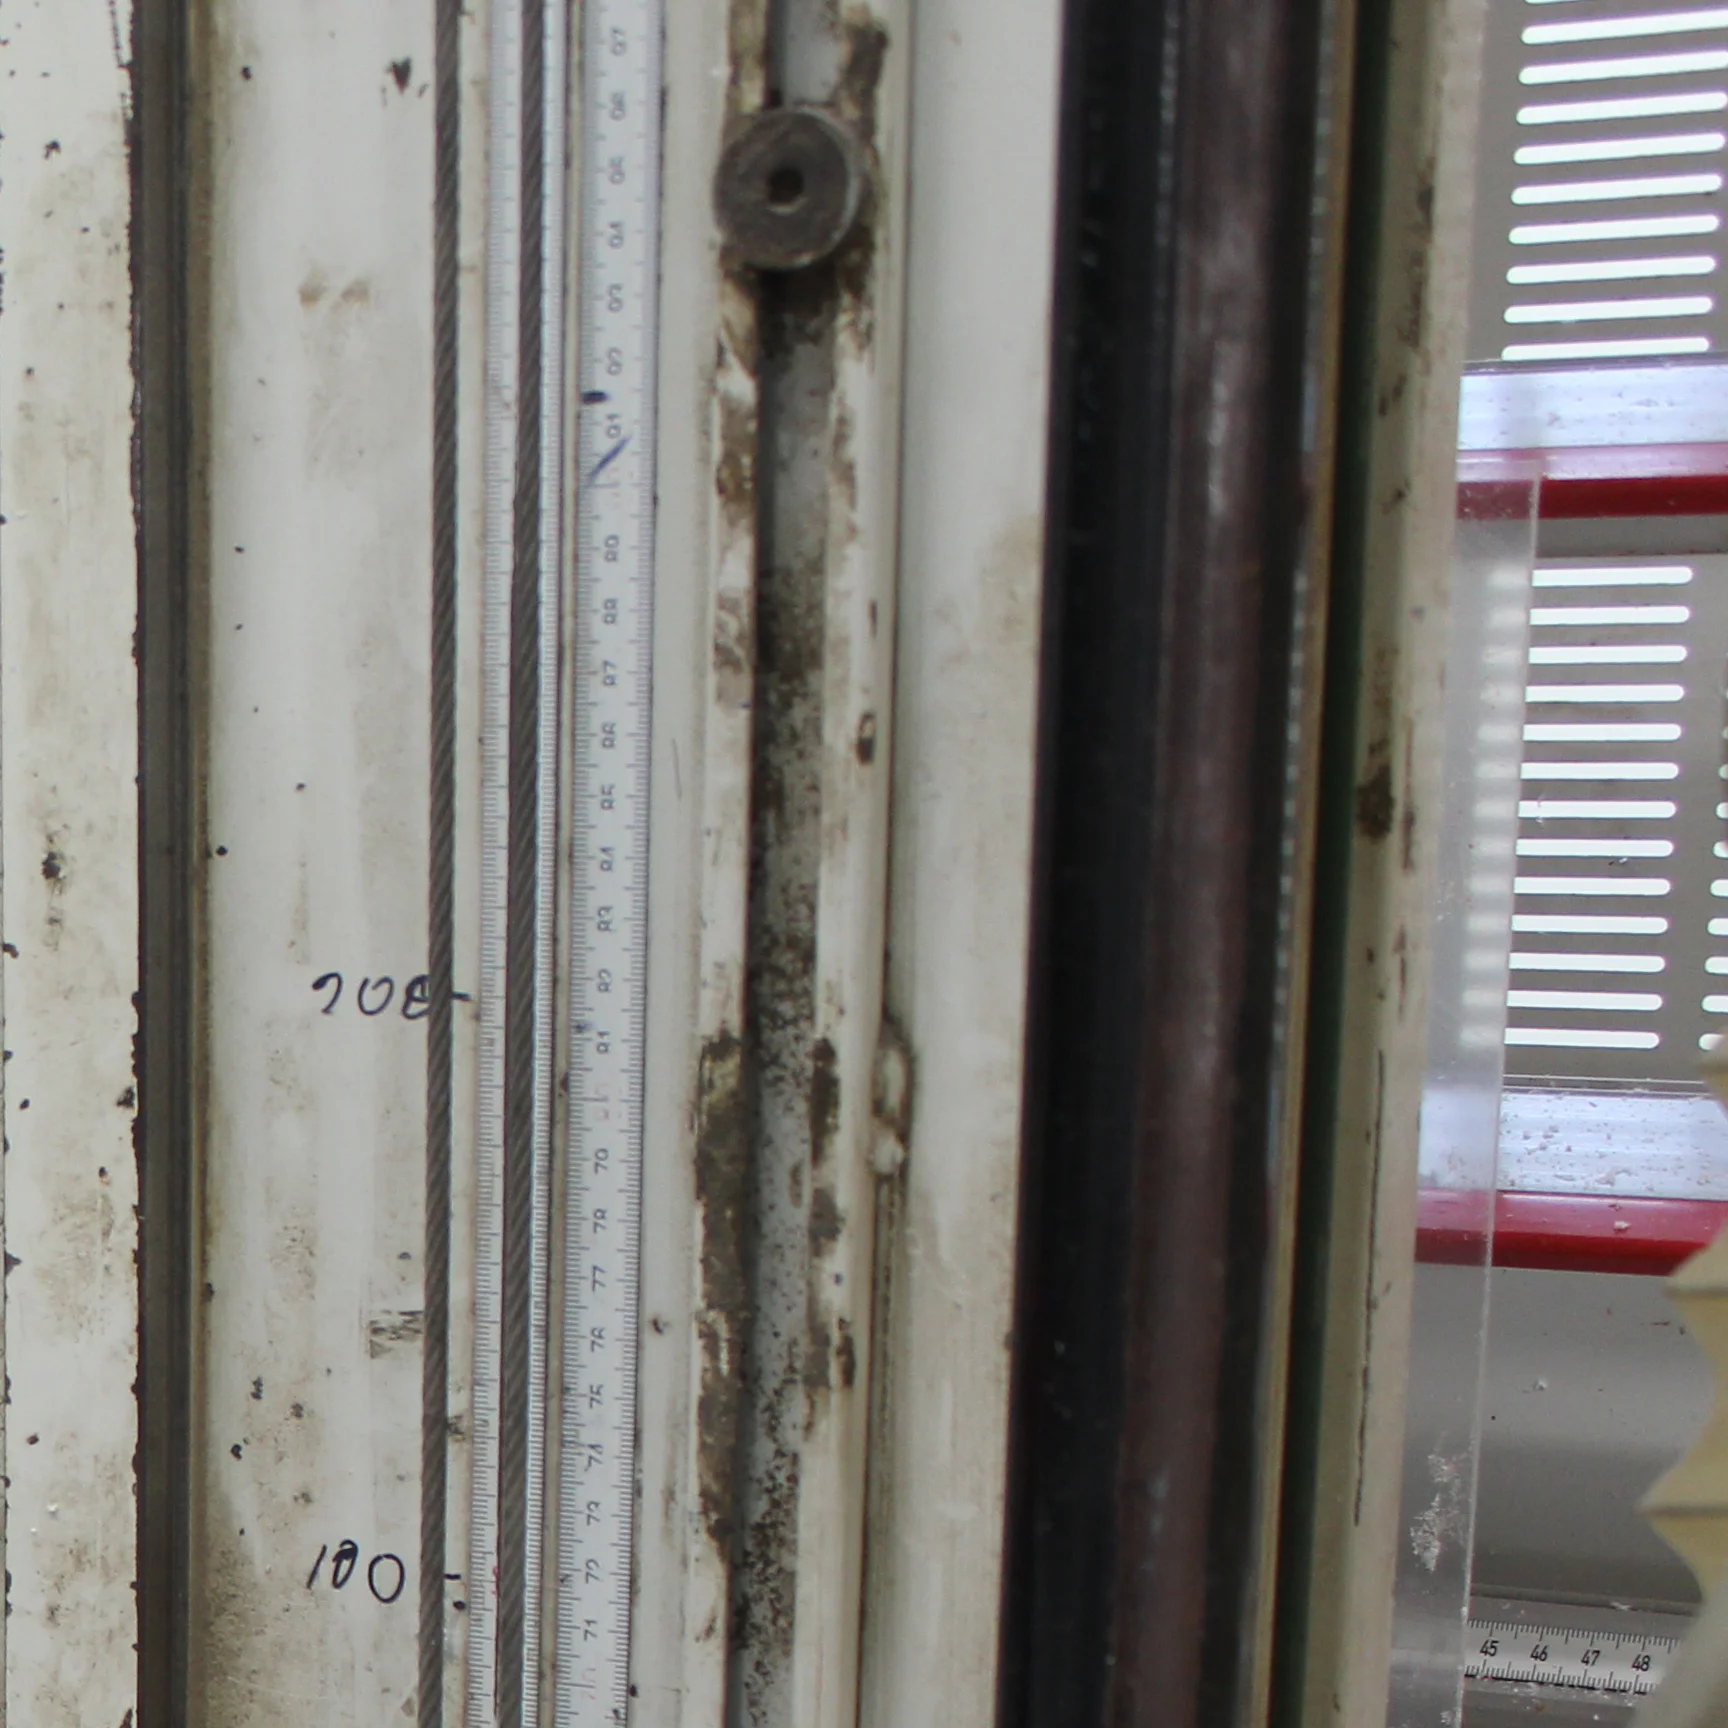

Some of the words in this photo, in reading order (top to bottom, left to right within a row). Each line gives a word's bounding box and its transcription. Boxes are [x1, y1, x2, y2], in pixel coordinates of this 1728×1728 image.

[1480, 1640, 1499, 1657] 45
[1530, 1645, 1548, 1662] 46
[1580, 1650, 1600, 1666] 47
[1631, 1654, 1651, 1672] 48
